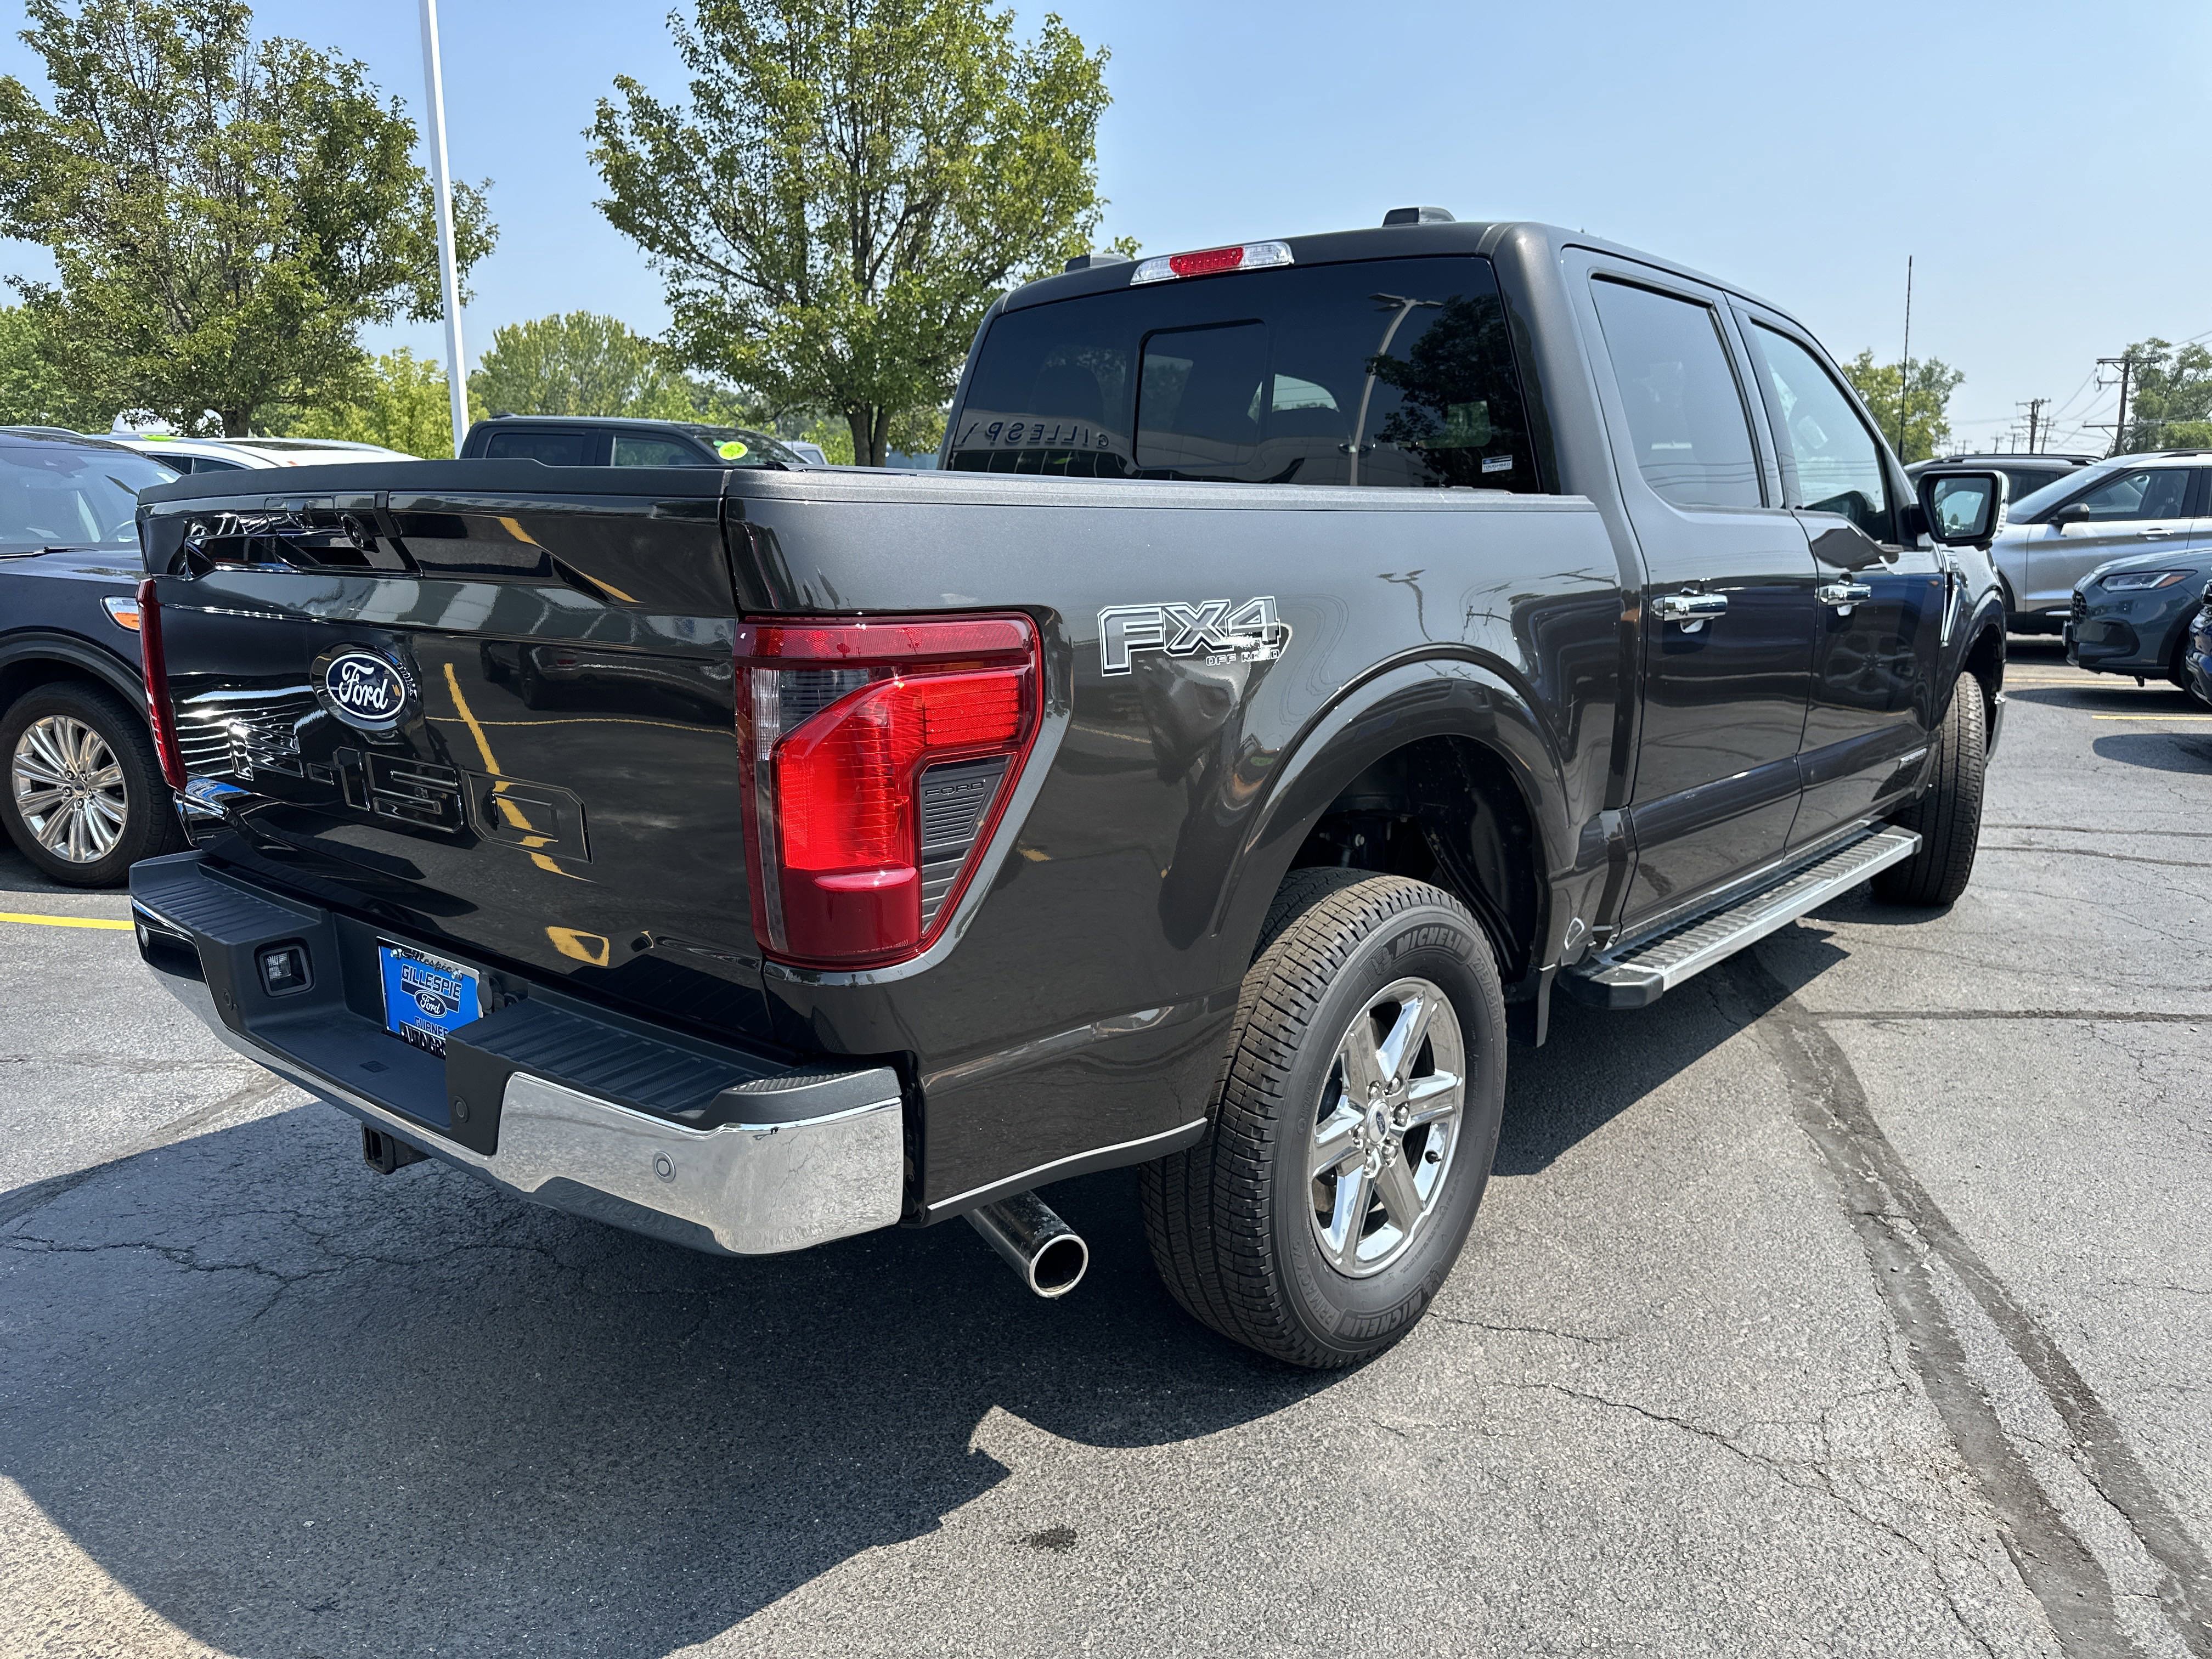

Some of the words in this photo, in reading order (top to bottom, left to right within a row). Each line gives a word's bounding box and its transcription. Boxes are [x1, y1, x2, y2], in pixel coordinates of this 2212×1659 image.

[1097, 596, 1282, 678] FX4
[1205, 653, 1237, 667] OFF
[1241, 649, 1280, 663] ROD
[337, 660, 389, 710] Ford
[924, 781, 984, 798] FORD
[1395, 927, 1471, 958] MICHELIN
[402, 963, 462, 1001] GILLESPIE
[420, 994, 441, 1014] Ford
[1296, 1263, 1335, 1325] PRIMACY
[1338, 1291, 1423, 1338] MICHELIN
